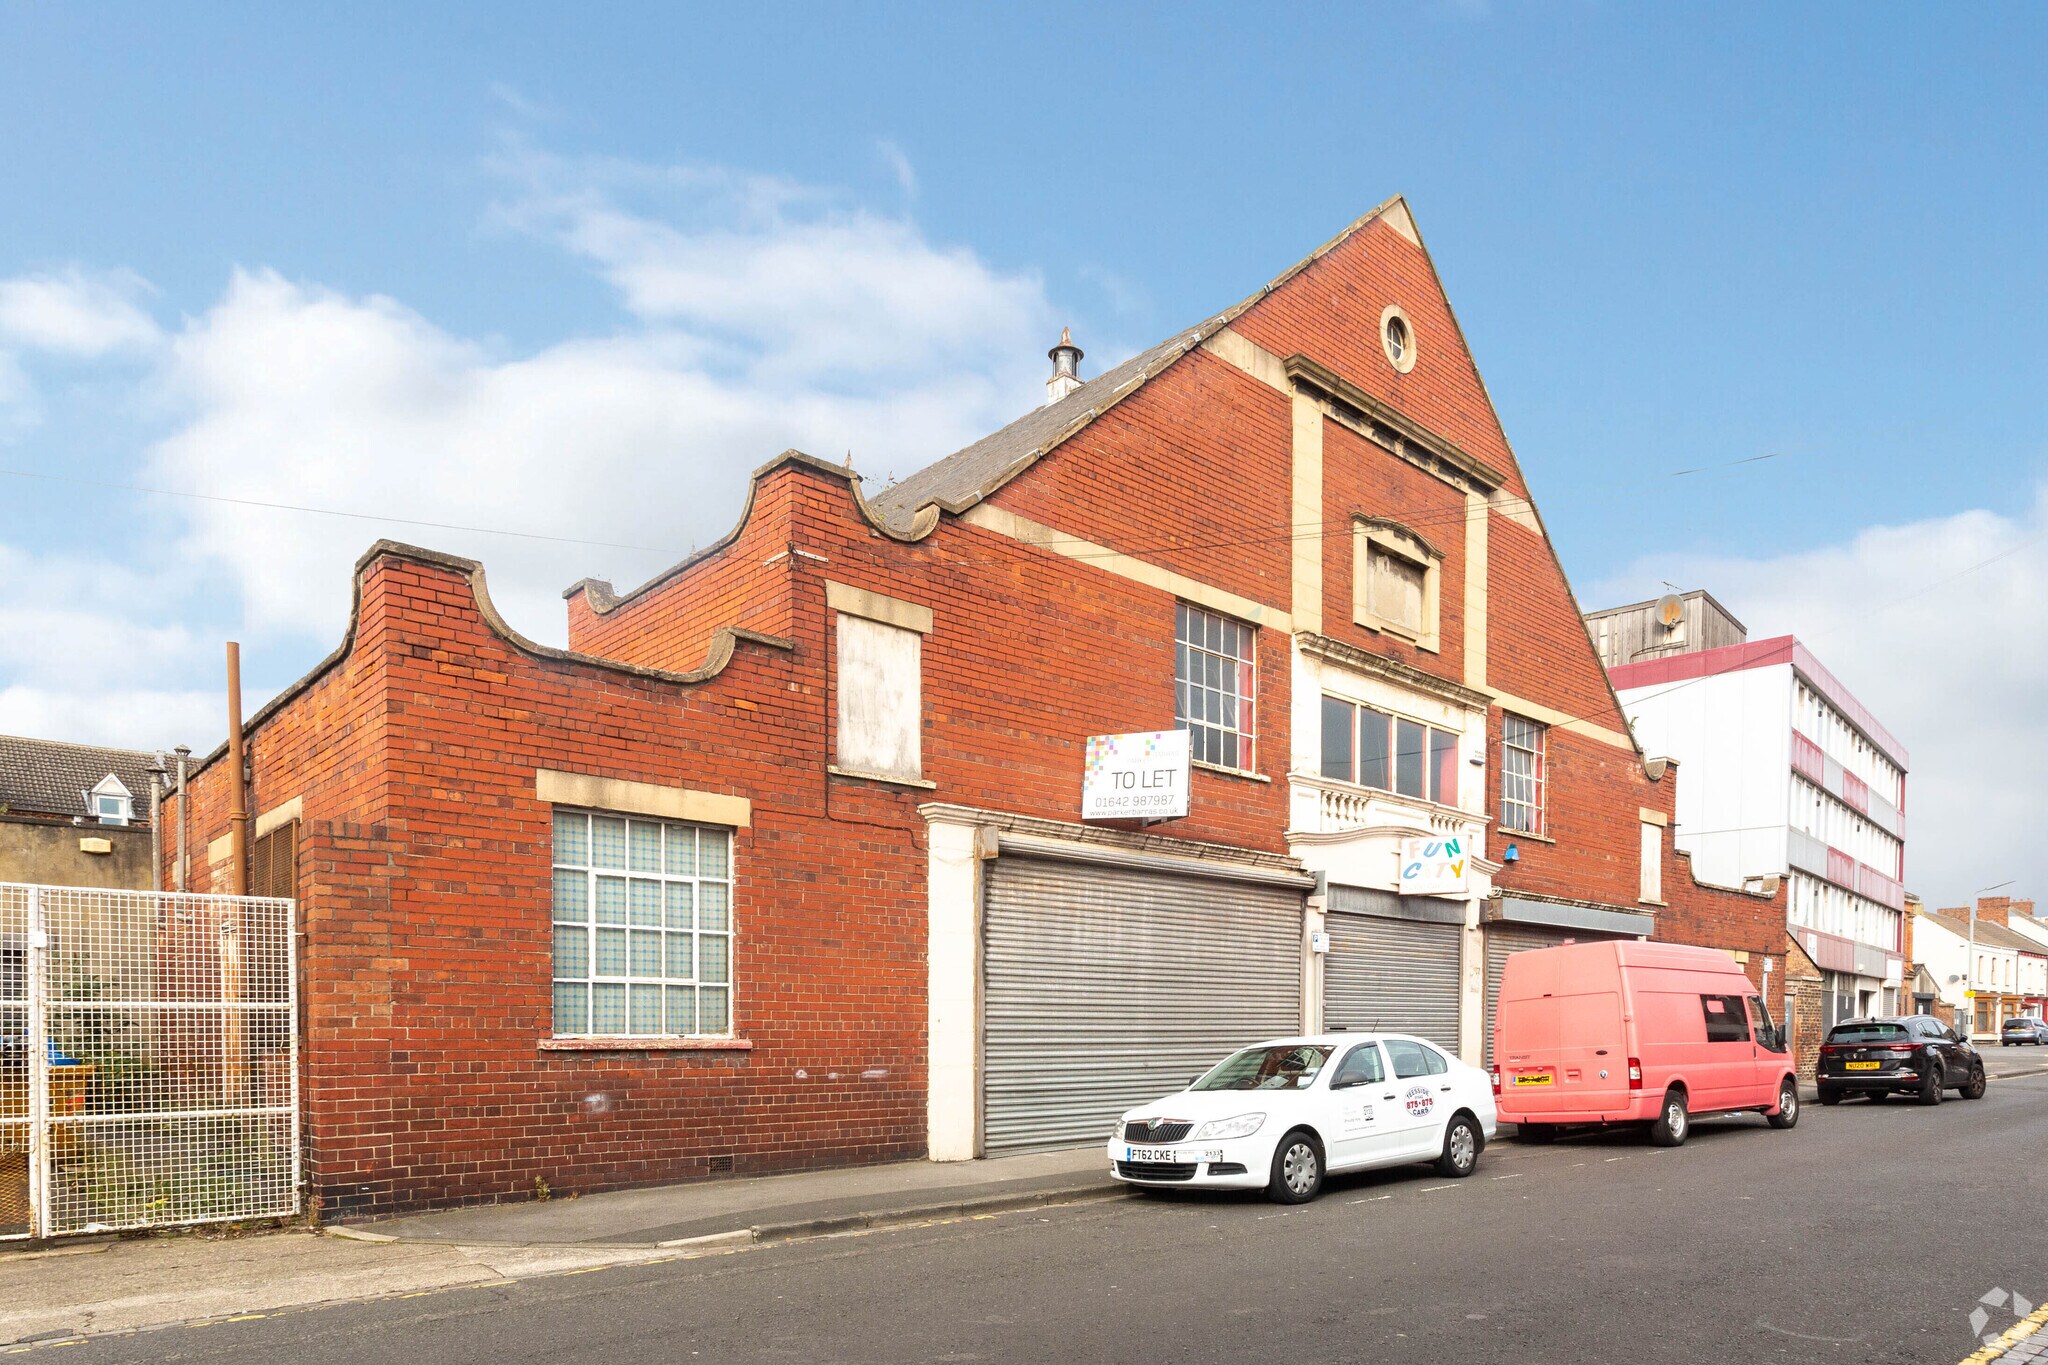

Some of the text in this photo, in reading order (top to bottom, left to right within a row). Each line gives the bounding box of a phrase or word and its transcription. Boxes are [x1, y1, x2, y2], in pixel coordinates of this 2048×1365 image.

[1112, 769, 1177, 789] TO LET
[1095, 795, 1174, 807] 01642 987987
[1408, 838, 1461, 859] FUN
[1402, 859, 1464, 879] CITY
[1407, 1088, 1429, 1099] TEESSIDE
[1413, 1107, 1429, 1115] CARS
[1132, 1149, 1171, 1161] FT62 CKE
